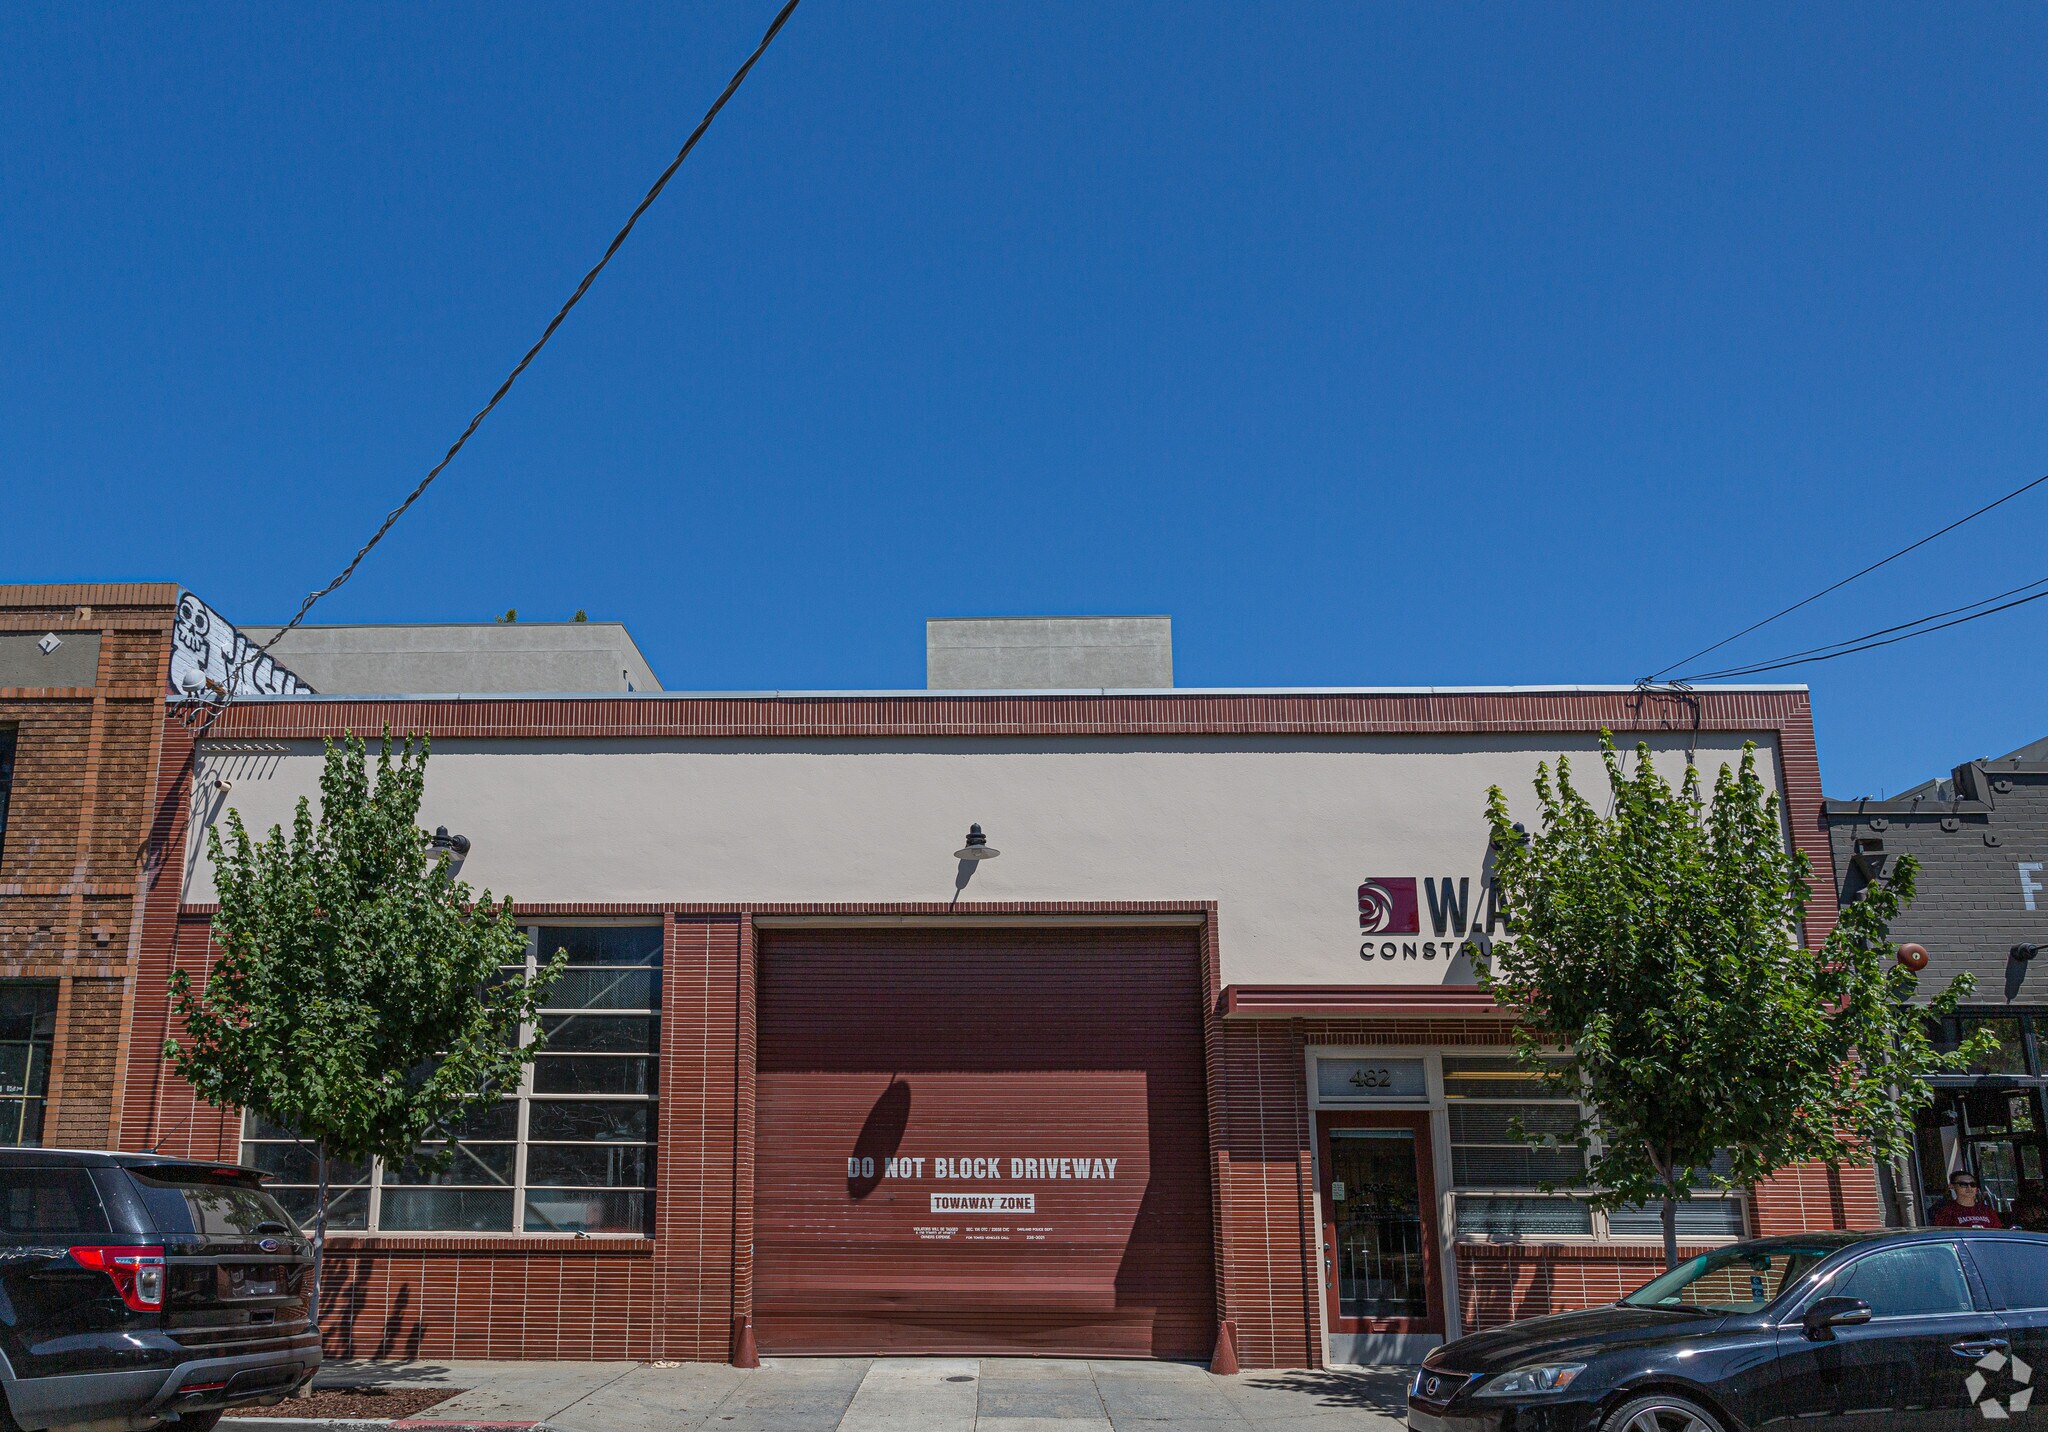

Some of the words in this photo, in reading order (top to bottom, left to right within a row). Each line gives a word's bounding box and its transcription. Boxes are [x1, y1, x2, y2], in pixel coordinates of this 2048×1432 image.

[848, 1157, 874, 1178] DO
[885, 1158, 926, 1179] NOT
[935, 1158, 1001, 1179] BLOCK
[1011, 1158, 1118, 1179] DRIVEWAY
[934, 1197, 995, 1210] TOWAWAY
[1000, 1197, 1031, 1210] ZONE
